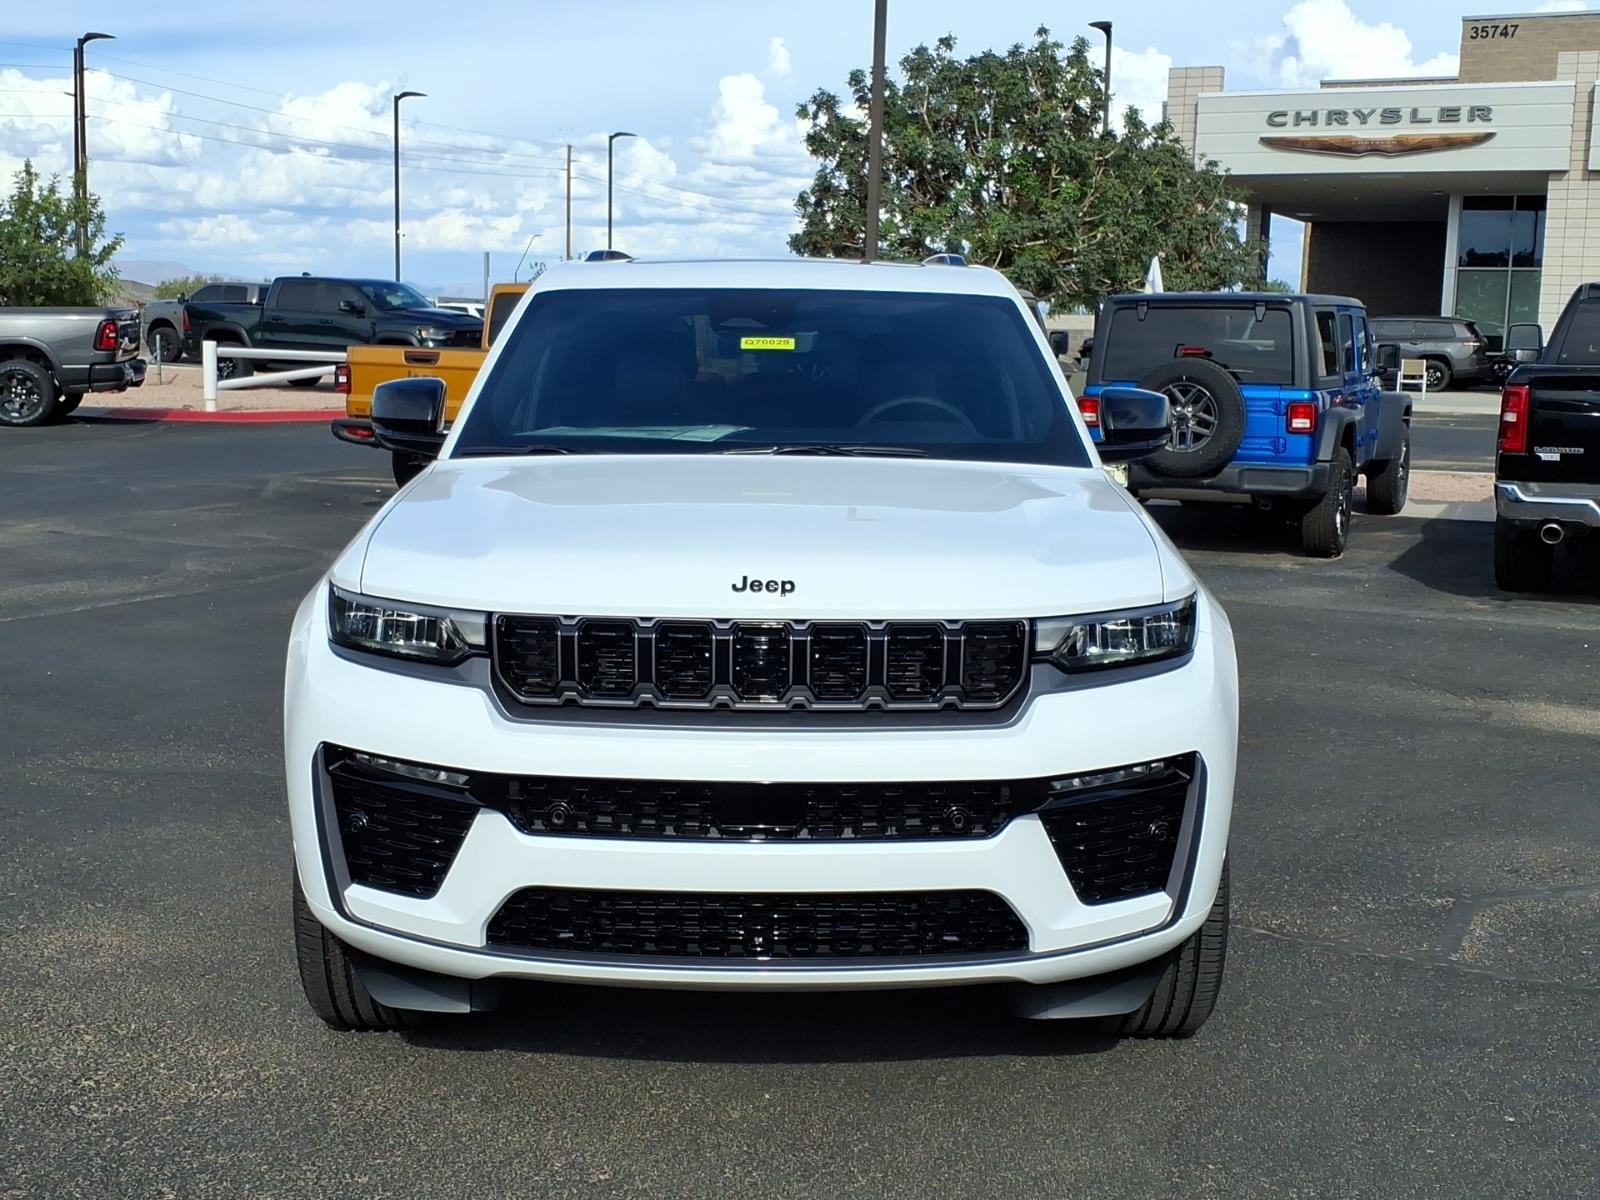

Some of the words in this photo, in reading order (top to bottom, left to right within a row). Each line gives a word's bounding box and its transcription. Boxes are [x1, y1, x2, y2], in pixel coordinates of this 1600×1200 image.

[1470, 24, 1519, 39] 35747
[1266, 105, 1493, 127] CHRYSLER
[731, 575, 796, 597] Jeep
